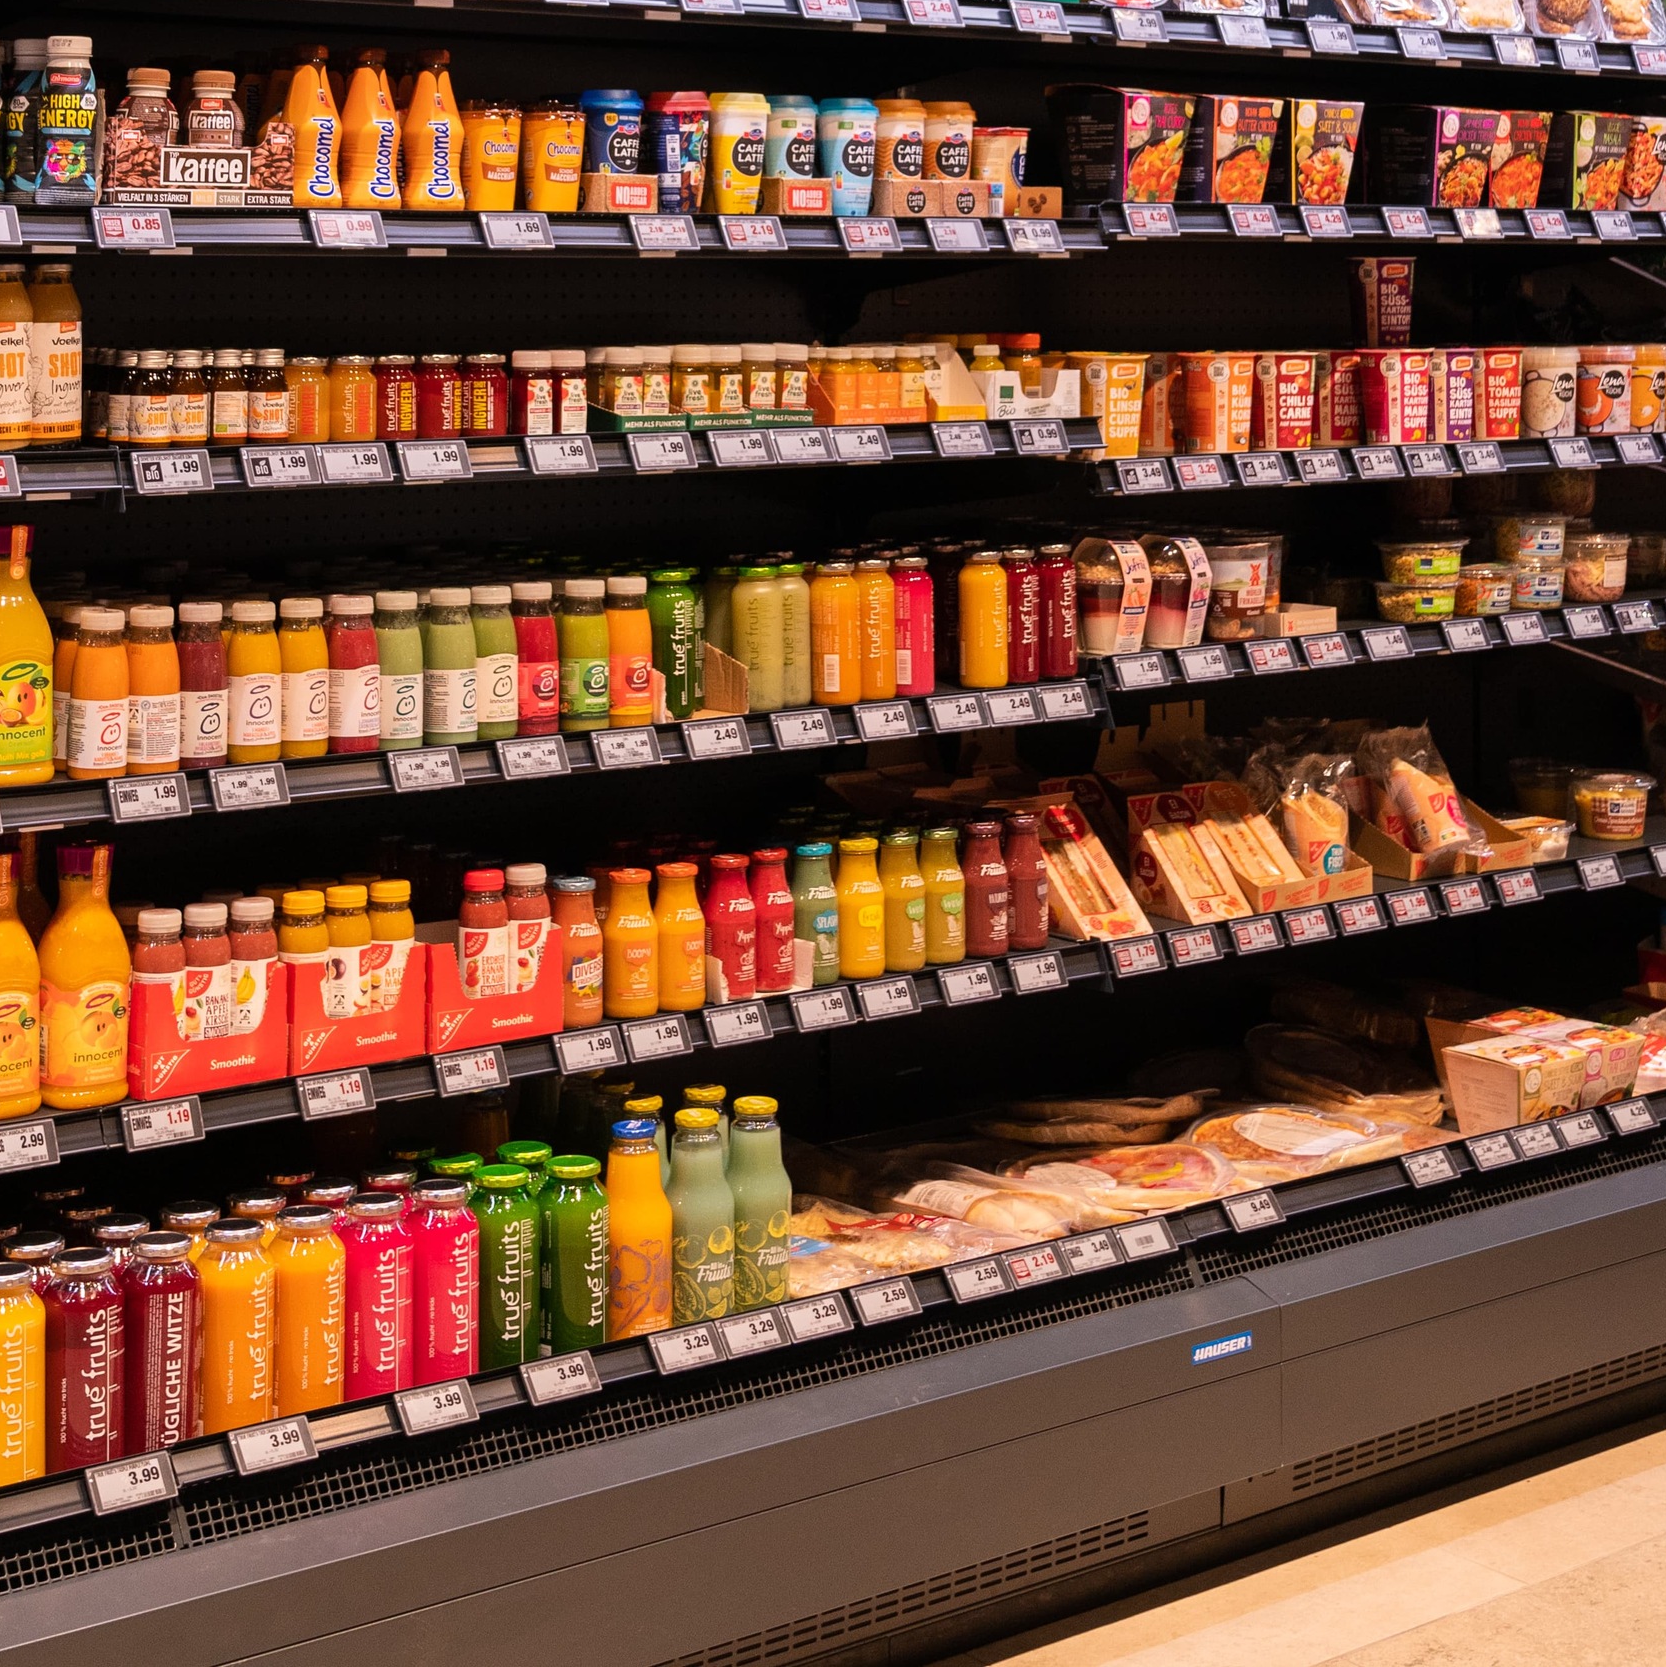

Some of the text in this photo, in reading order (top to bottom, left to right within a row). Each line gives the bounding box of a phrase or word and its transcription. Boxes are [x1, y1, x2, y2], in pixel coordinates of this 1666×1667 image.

[50, 93, 81, 109] HIGH
[40, 109, 97, 130] ENERGY
[169, 151, 180, 159] TYP
[309, 118, 334, 197] Chocomel
[428, 122, 453, 198] Chocomel
[614, 149, 639, 161] LATTE
[168, 154, 243, 185] Kaffee
[118, 192, 188, 203] VIELFALT IN 3 STÄRKEN
[219, 193, 240, 204] STARK
[615, 185, 629, 205] NO
[630, 186, 647, 196] ADDED
[247, 194, 291, 205] EXTRA STARK
[631, 196, 648, 206] SUGAR
[131, 218, 161, 231] 0.85
[1253, 213, 1271, 223] 4.29
[515, 222, 540, 233] 1.69
[750, 224, 774, 235] 2.19
[1381, 284, 1399, 295] BIO
[385, 382, 396, 432] true fruits
[1279, 395, 1303, 407] CHILI
[400, 389, 413, 432] INGWER
[1488, 408, 1517, 419] SUPPE
[624, 421, 643, 429] MEHR
[655, 420, 686, 428] FUNKTION
[144, 461, 199, 482] BIO 1.99
[674, 600, 686, 676] true fruits
[119, 784, 177, 804] EINWEG 1.99
[1462, 887, 1479, 898] 1.99
[492, 1013, 533, 1028] Smoothie
[210, 1054, 256, 1070] Smoothie
[339, 1079, 361, 1095] 1.19
[1249, 1198, 1273, 1213] 9.49
[166, 1292, 183, 1363] WITZE
[1194, 1336, 1247, 1361] HAUSER
[0, 1323, 23, 1459] true fruits
